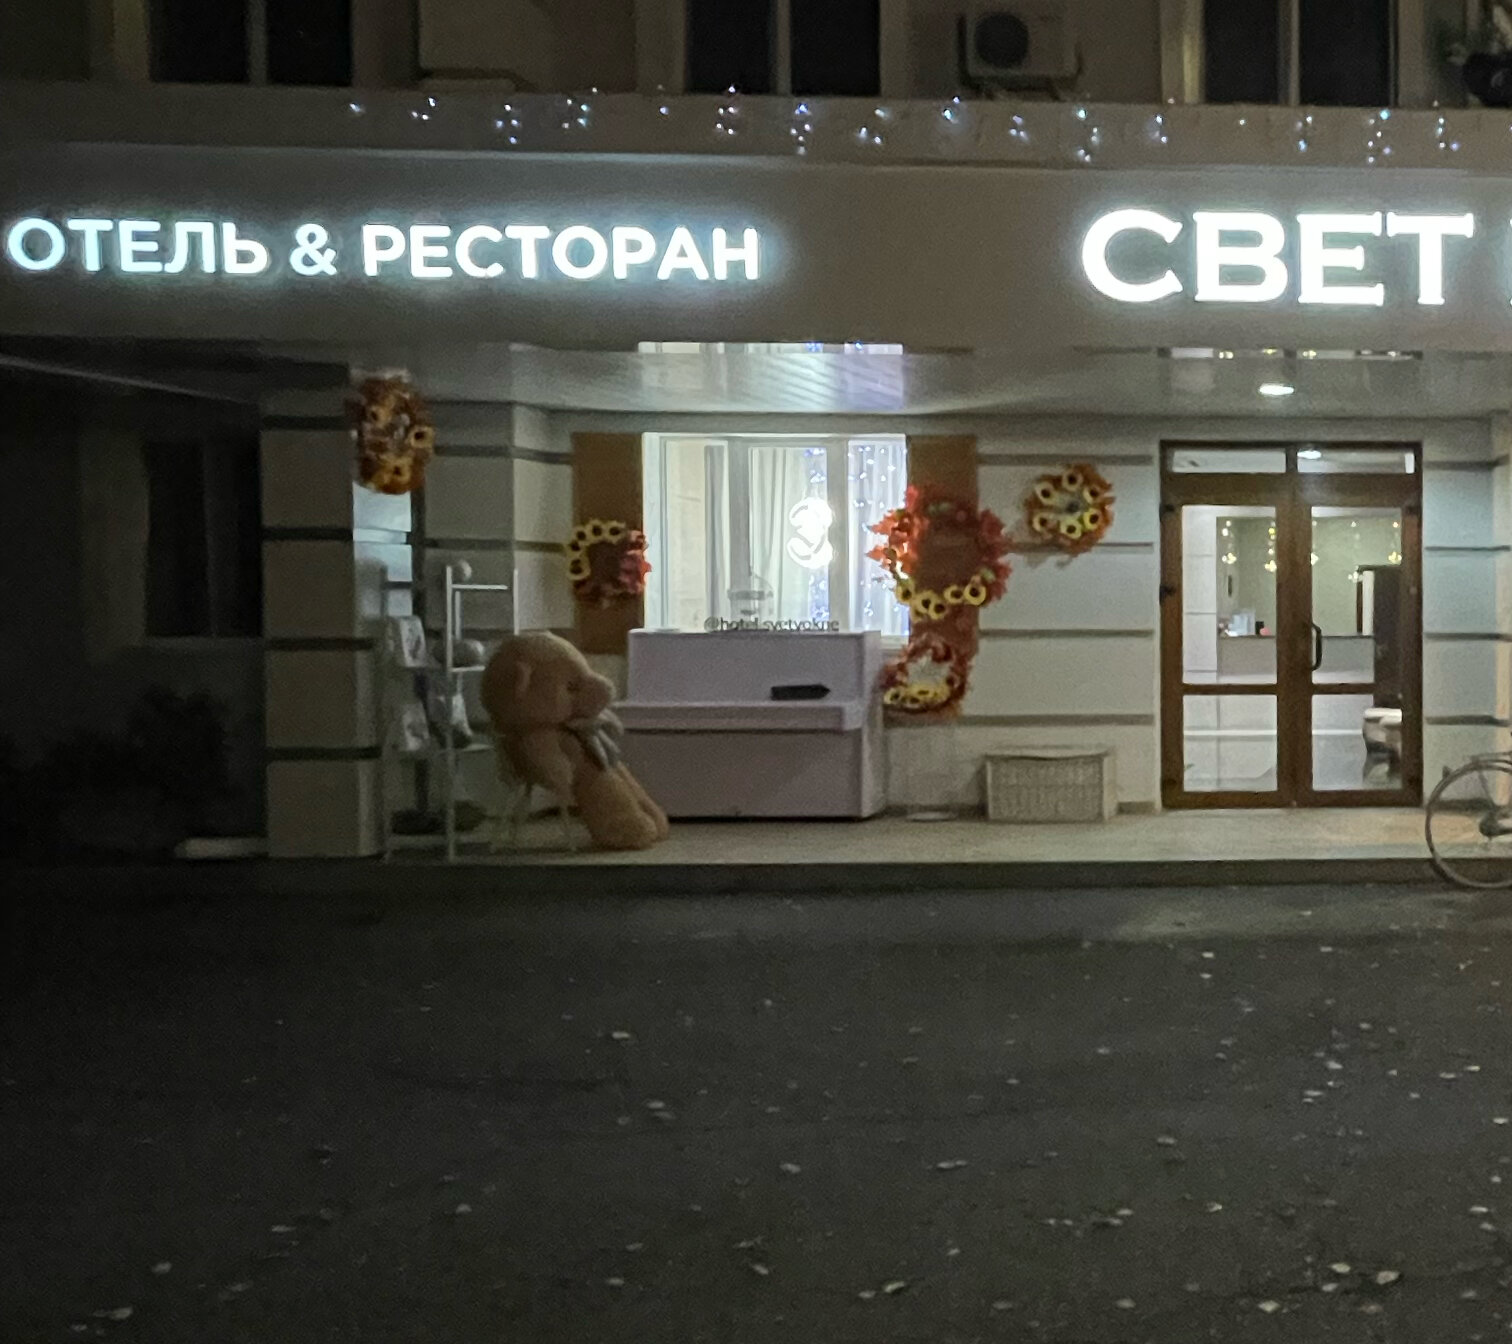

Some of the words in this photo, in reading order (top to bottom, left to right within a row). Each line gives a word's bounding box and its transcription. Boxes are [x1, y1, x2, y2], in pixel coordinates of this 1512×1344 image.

[8, 218, 268, 273] ОТЕЛЬ
[289, 223, 338, 276] &
[361, 224, 760, 281] РЕСТОРАН
[1081, 208, 1475, 306] СВЕТ
